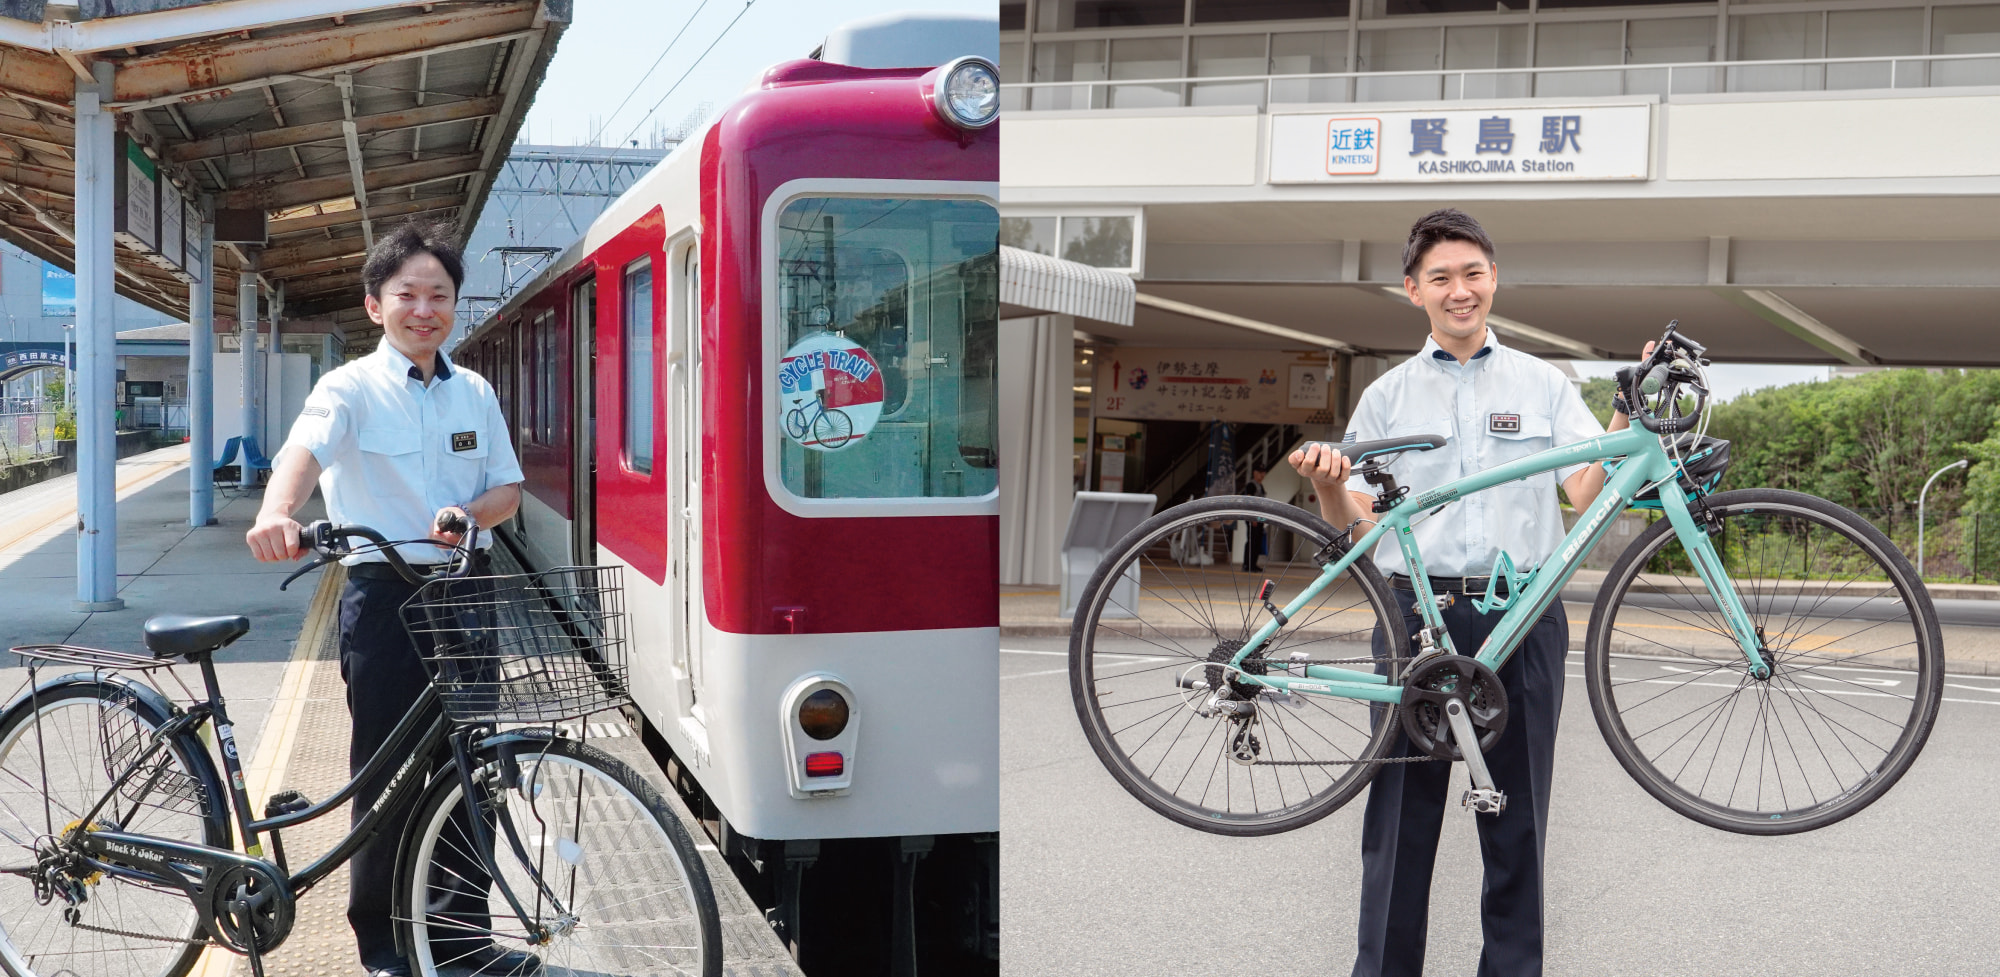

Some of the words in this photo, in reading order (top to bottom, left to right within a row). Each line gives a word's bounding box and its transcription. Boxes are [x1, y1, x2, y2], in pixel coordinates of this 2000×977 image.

[1332, 128, 1375, 150] 近鉄
[1409, 115, 1581, 156] 賢島駅
[1332, 154, 1373, 164] KINTETSU
[1418, 160, 1516, 174] KASHIKOJIMA
[1522, 159, 1574, 172] Station
[779, 349, 825, 388] CYCLE
[828, 349, 875, 382] TRAIN
[1156, 361, 1220, 376] 伊勢志摩
[1156, 385, 1252, 400] サミット記念館
[1106, 397, 1125, 411] 2F
[1178, 404, 1227, 413] サミエール
[1562, 488, 1621, 563] Bianchi
[372, 786, 392, 813] Black
[397, 753, 416, 781] Joker
[106, 841, 129, 855] Black
[138, 849, 164, 862] Joker
